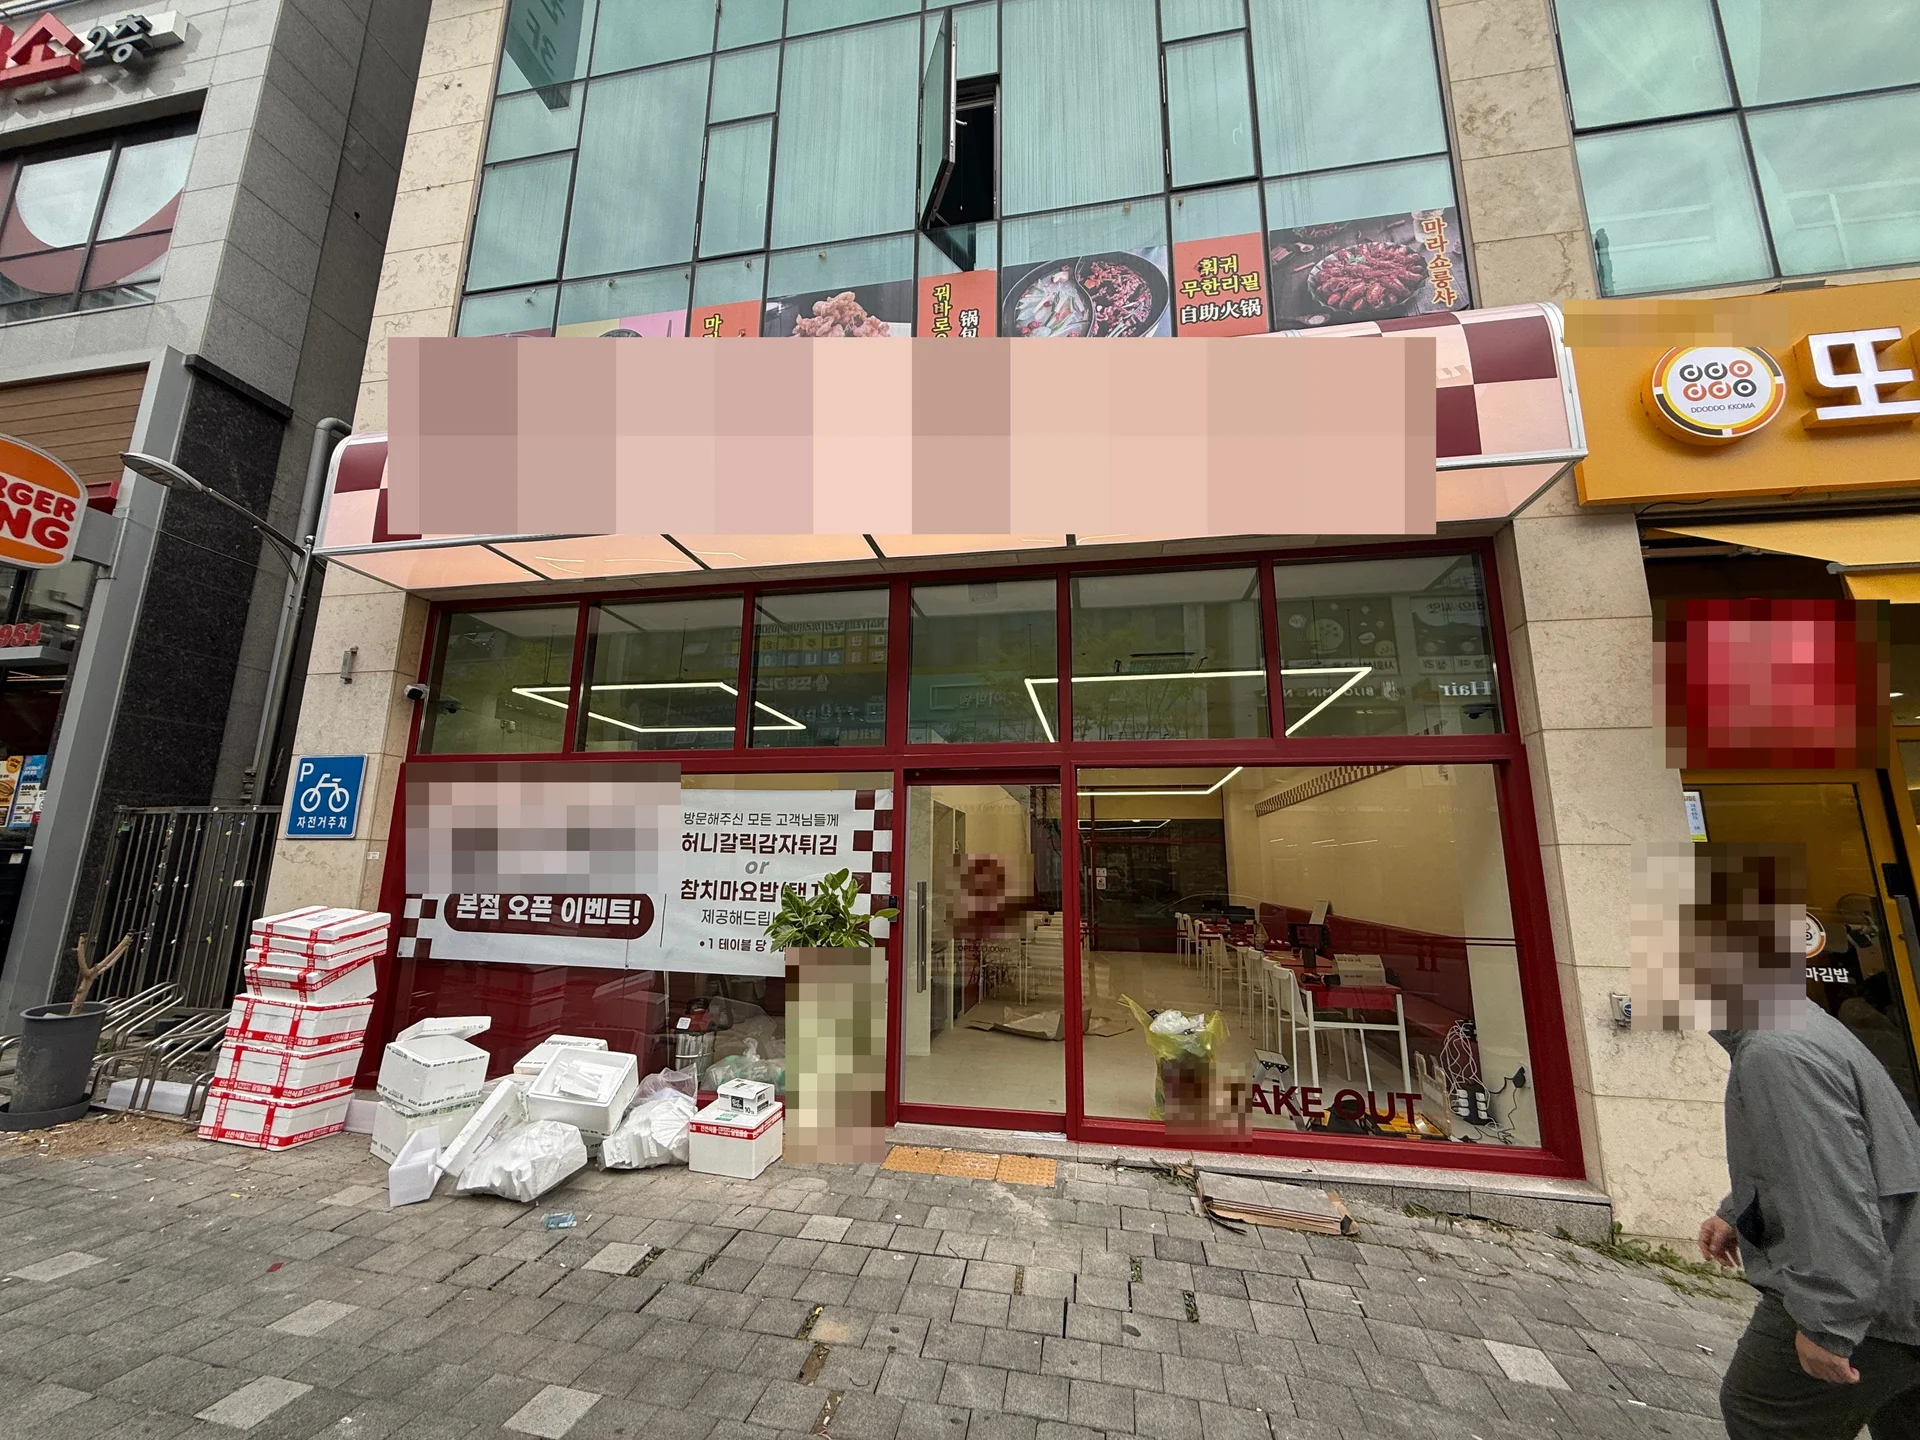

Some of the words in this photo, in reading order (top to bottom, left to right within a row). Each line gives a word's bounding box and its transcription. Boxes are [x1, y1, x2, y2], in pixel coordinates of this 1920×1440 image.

[0, 12, 84, 88] 소
[80, 14, 152, 64] 2층
[1200, 253, 1239, 276] 훠궈
[1421, 216, 1457, 308] 마라쇼룽샤
[1181, 272, 1261, 298] 무한리필
[1180, 297, 1262, 325] 自助火锅
[1691, 404, 1726, 414] DDODDO
[1728, 402, 1756, 411] KKOMA
[300, 763, 314, 782] P
[296, 815, 347, 829] 자전거주차
[683, 811, 744, 827] 방문해주신
[748, 812, 772, 827] 모든
[775, 813, 839, 828] 고객님들께
[681, 832, 838, 856] 허니갈릭감자튀김
[745, 860, 770, 875] or
[456, 893, 500, 920] 본점
[507, 894, 553, 923] 오픈
[560, 896, 641, 925] 이벤트!
[701, 908, 776, 927] 제공해드립
[718, 938, 752, 952] 테이블
[755, 939, 767, 952] 당
[1252, 1084, 1325, 1118] AKE
[1334, 1088, 1422, 1125] OUT
